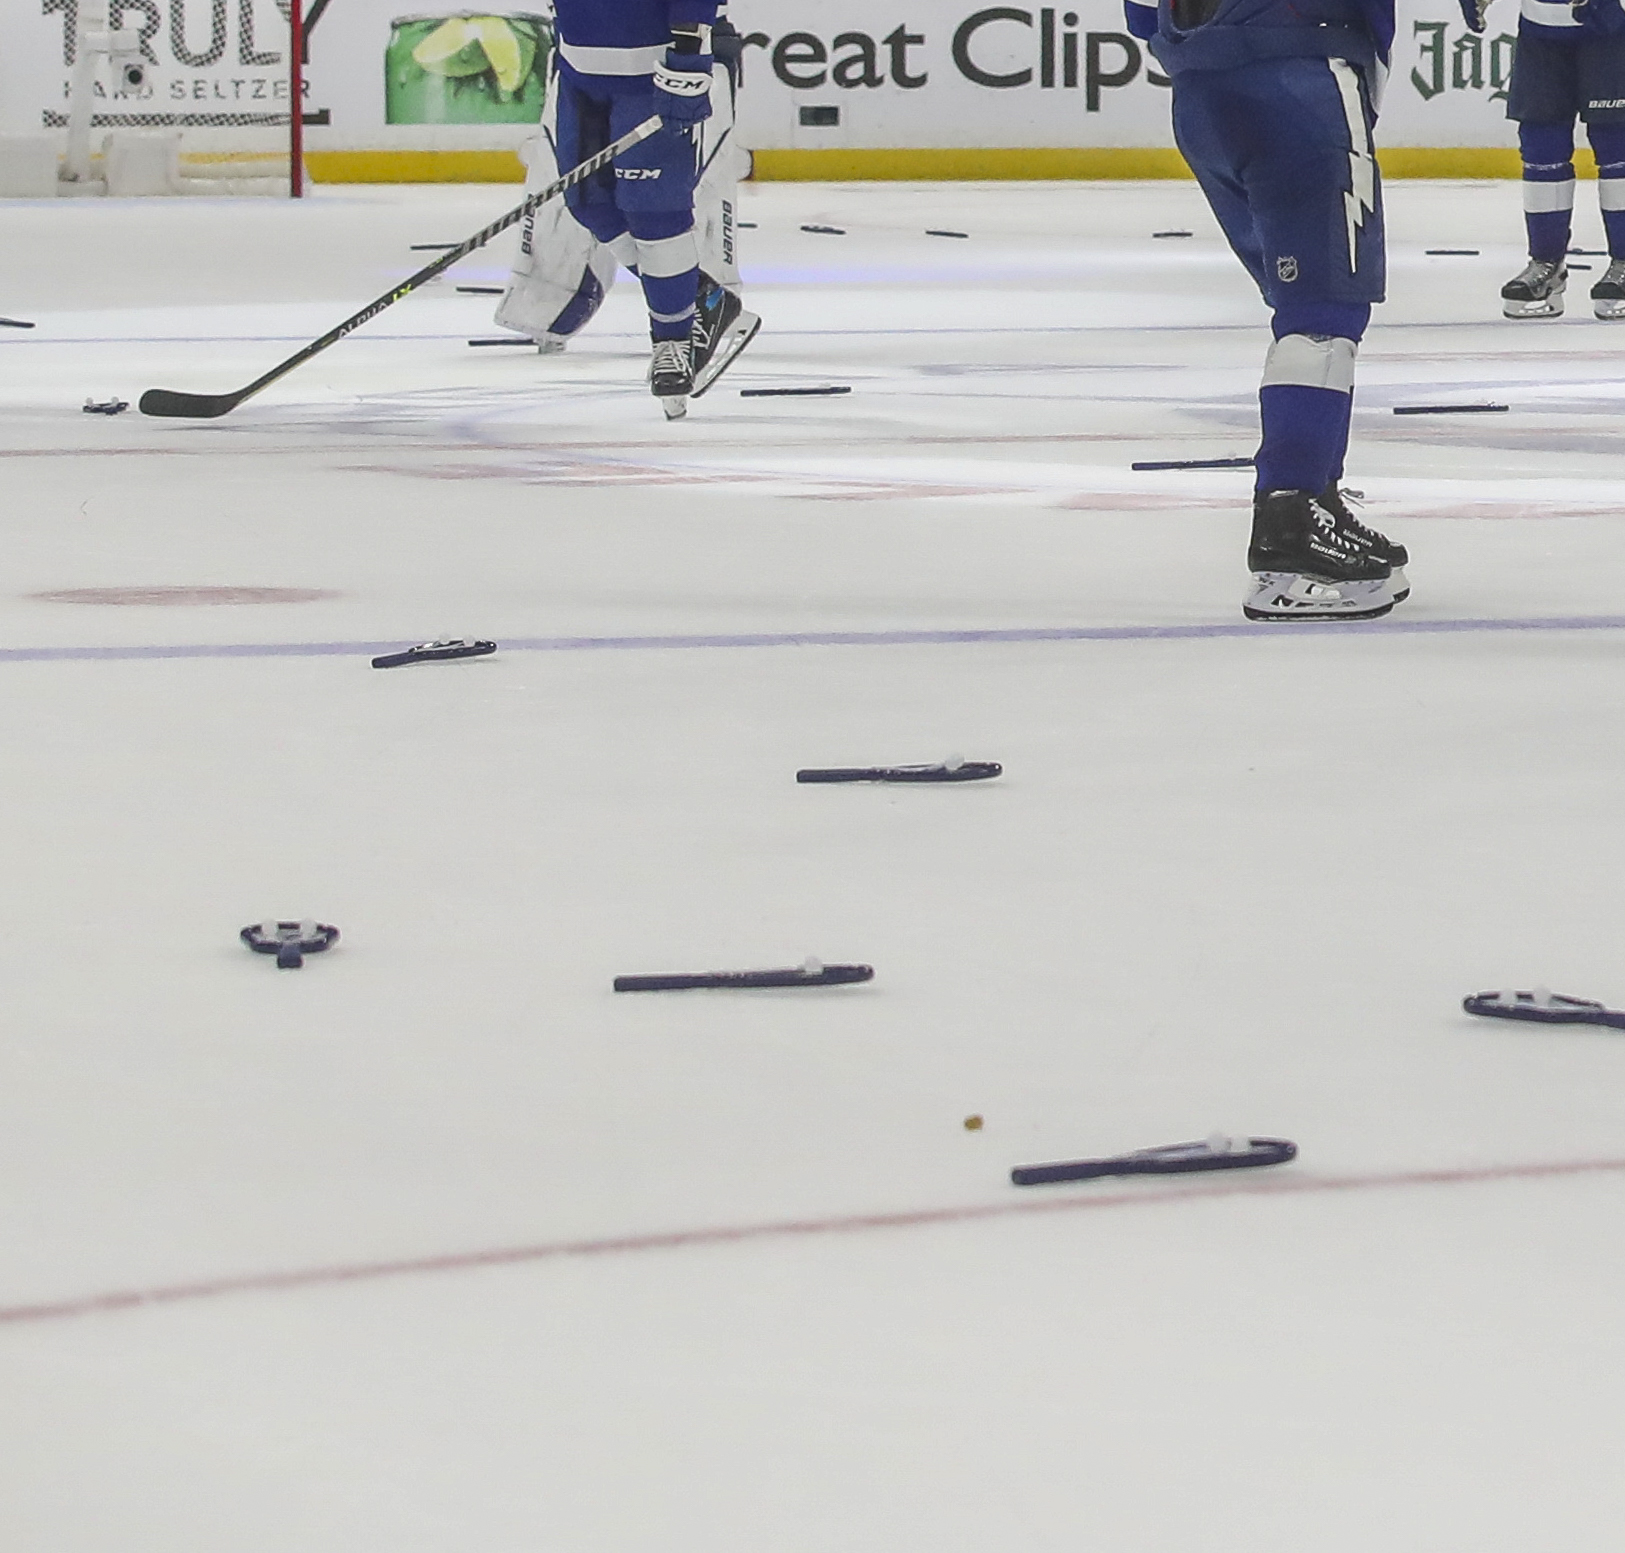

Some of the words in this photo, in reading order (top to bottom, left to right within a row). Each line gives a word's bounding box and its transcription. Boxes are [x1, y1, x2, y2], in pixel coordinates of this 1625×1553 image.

[736, 20, 930, 90] reat
[170, 80, 311, 100] SELTZER
[721, 199, 734, 266] BAUER
